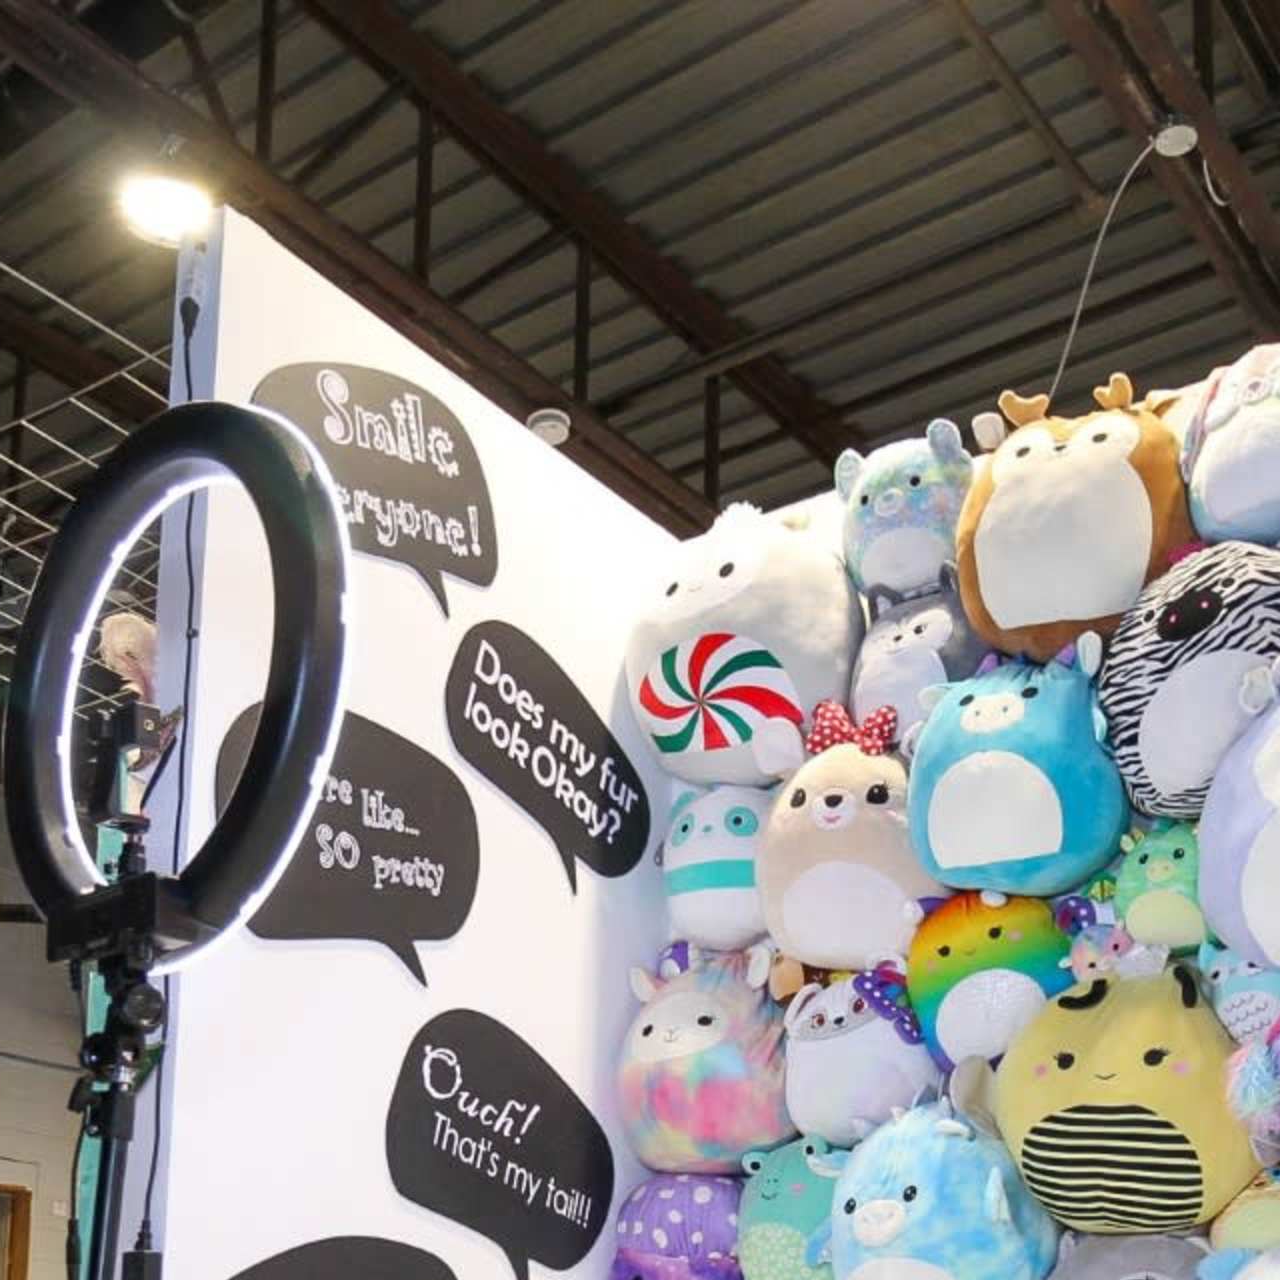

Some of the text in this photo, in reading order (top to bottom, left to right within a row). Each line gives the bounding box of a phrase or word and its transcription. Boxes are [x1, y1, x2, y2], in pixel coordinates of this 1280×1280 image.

[316, 368, 460, 478] Smile
[334, 482, 482, 557] eryone!
[464, 682, 621, 844] look Okay?
[474, 639, 638, 813] Does my fur
[315, 823, 445, 896] SO pretty
[422, 1044, 541, 1144] Ouch!
[433, 1111, 592, 1228] That's my tail!!
